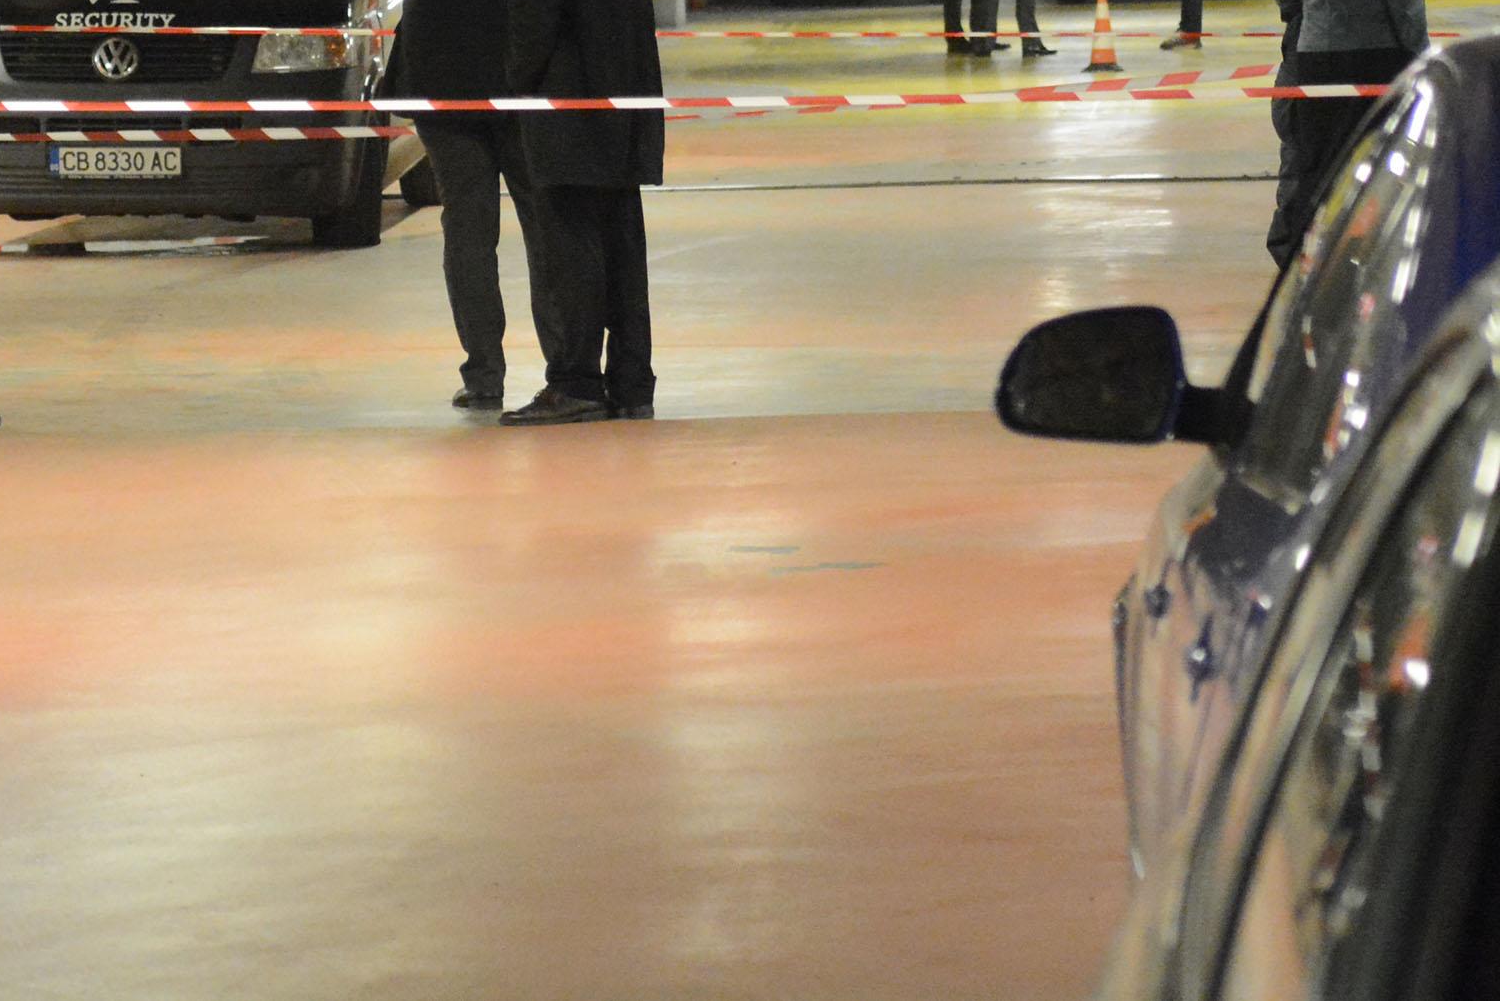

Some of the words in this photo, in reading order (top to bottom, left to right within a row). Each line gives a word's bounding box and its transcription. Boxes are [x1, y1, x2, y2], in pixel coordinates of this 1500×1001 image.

[54, 12, 177, 29] SECURITY
[62, 151, 90, 171] CB
[94, 151, 145, 171] 8330
[150, 151, 178, 171] AC
